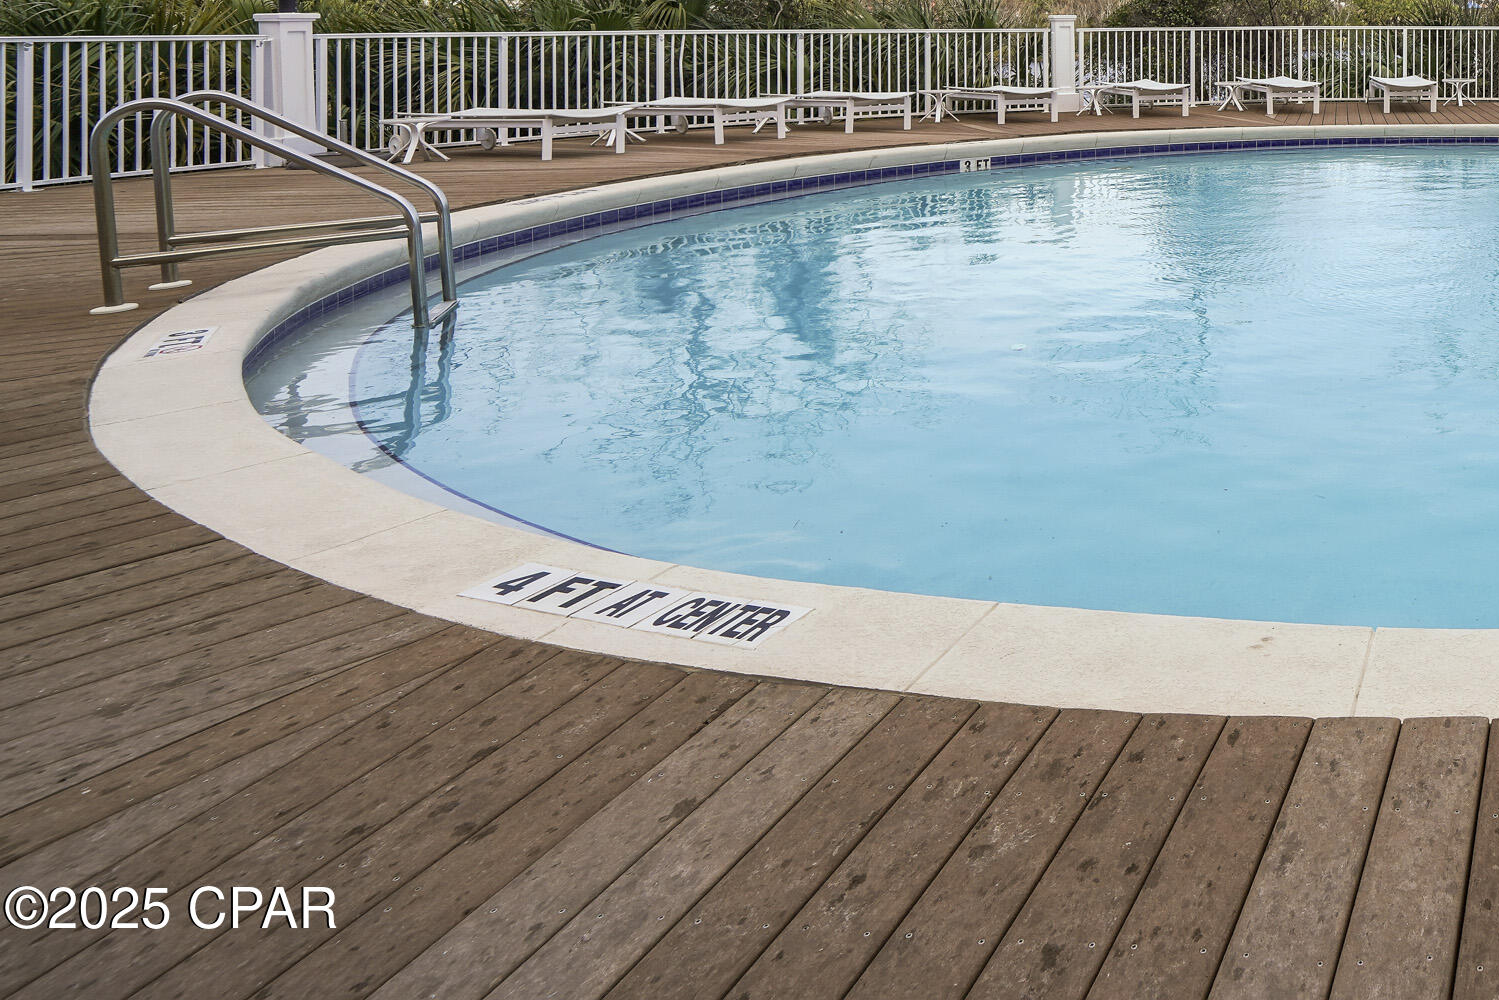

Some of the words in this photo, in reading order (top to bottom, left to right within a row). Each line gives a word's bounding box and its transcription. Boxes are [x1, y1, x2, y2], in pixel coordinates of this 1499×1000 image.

[976, 159, 989, 171] FT
[492, 571, 552, 596] 4
[525, 576, 623, 608] FT
[593, 589, 671, 619] AT
[651, 597, 791, 642] CENTER
